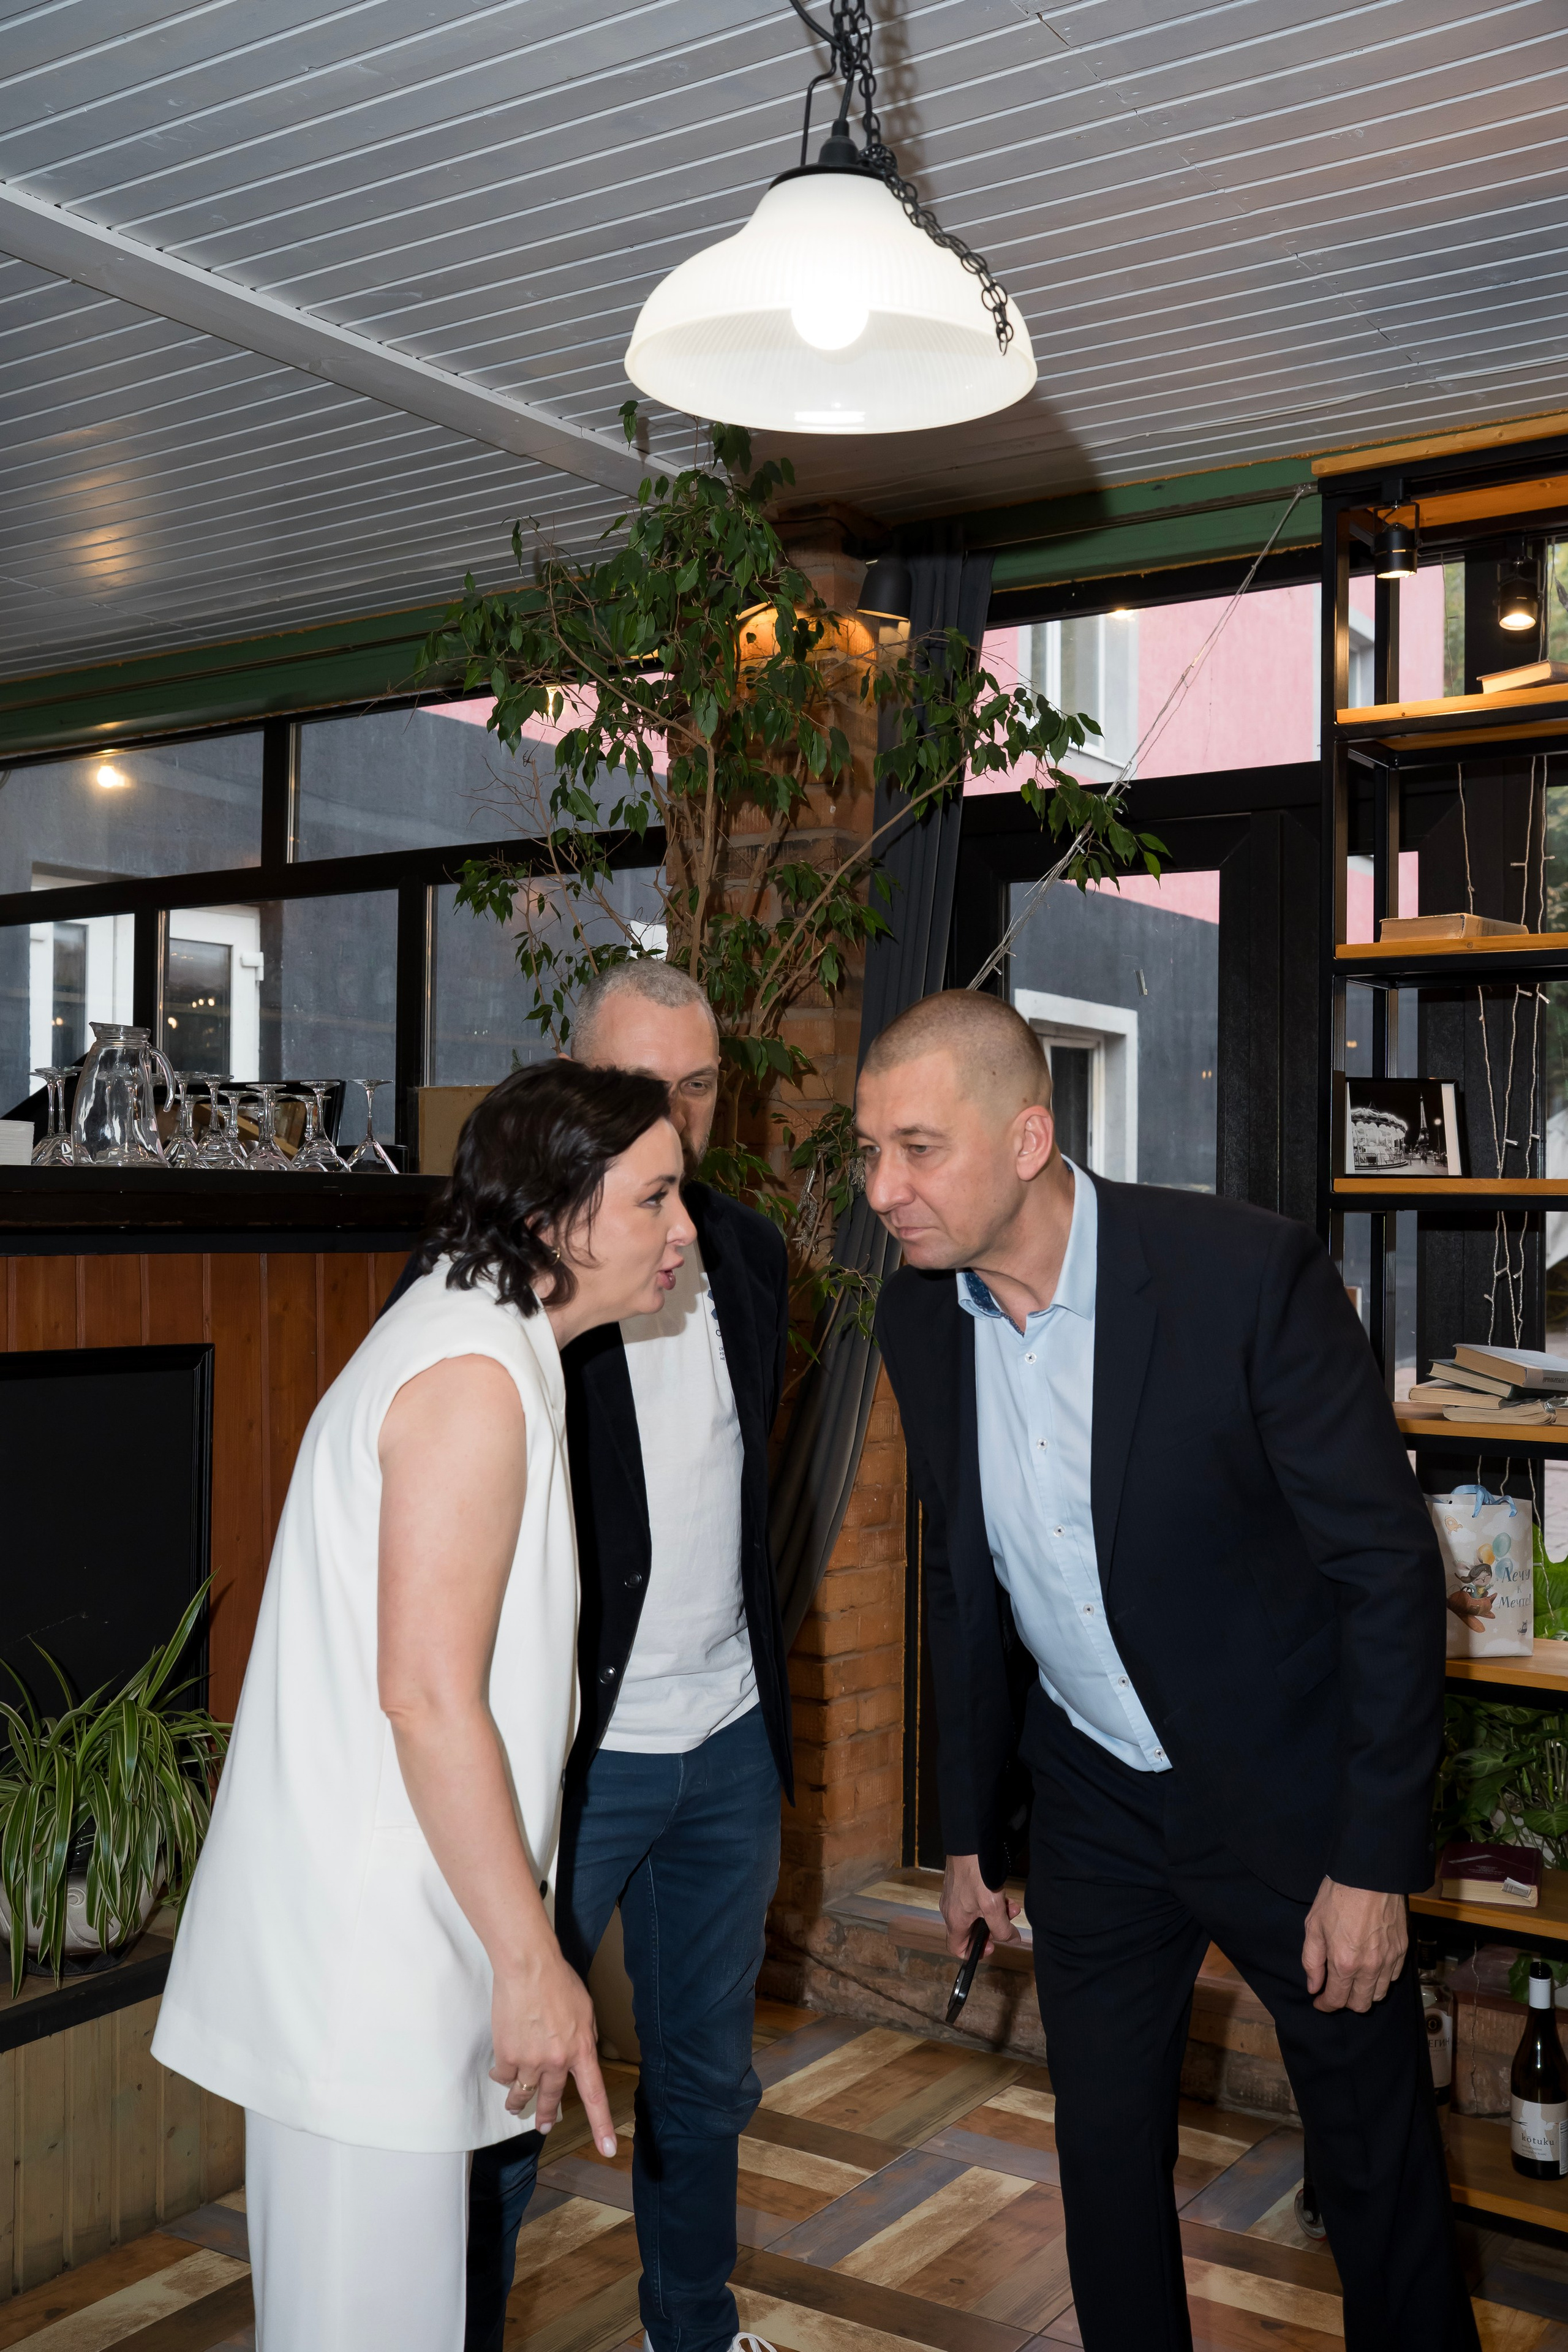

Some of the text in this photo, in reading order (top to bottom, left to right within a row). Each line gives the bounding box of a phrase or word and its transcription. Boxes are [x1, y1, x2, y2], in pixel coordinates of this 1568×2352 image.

[1502, 1567, 1530, 1583] Лечу
[1429, 2037, 1449, 2048] ЕГИН
[1521, 2133, 1554, 2145] kōtuku
